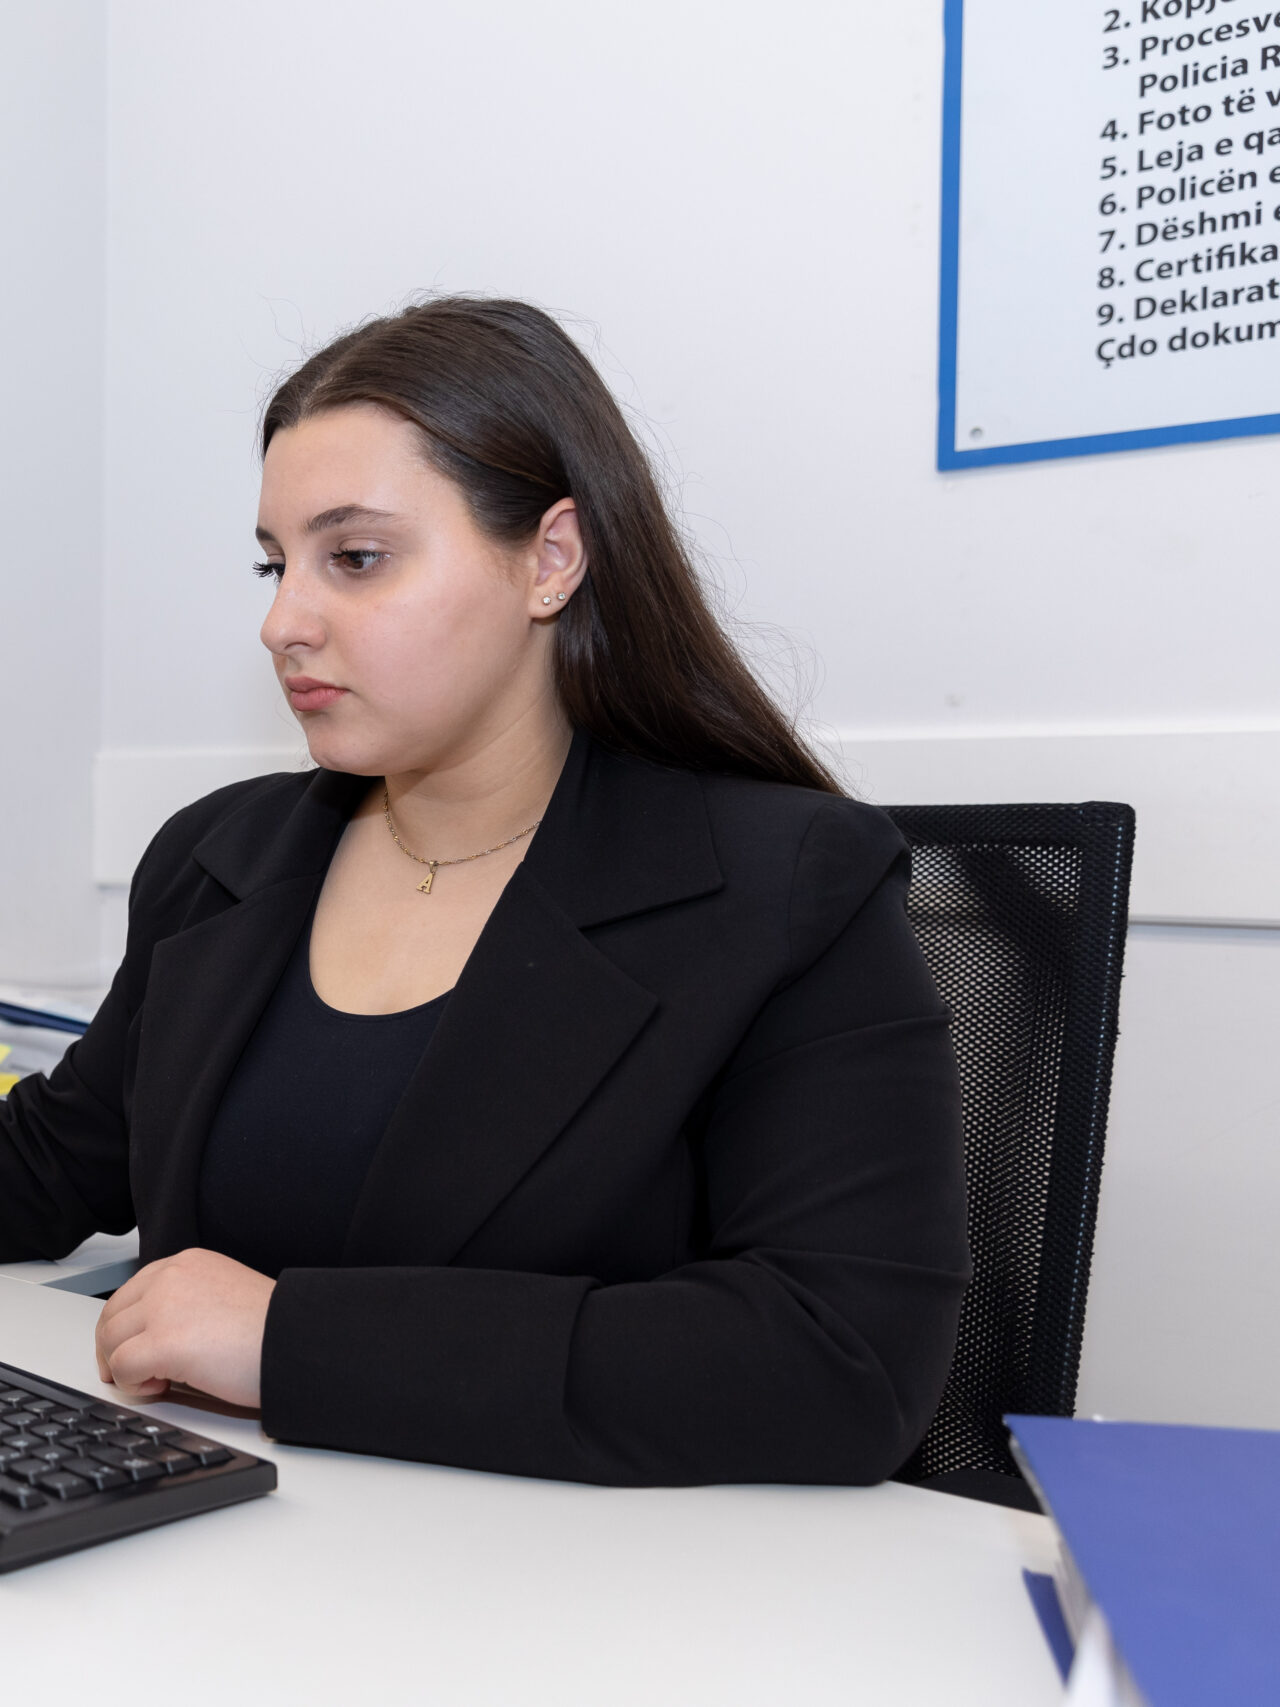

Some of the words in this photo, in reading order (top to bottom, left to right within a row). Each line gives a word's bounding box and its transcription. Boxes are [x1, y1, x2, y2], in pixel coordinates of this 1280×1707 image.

[1103, 9, 1131, 33] 2.
[1103, 46, 1130, 70] 3.
[1139, 55, 1249, 98] Policia
[1100, 119, 1128, 142] 4.
[1138, 104, 1213, 136] Foto
[1221, 87, 1256, 117] të
[1100, 156, 1127, 180] 5.
[1137, 140, 1204, 173] Leja
[1214, 137, 1234, 157] e
[1099, 192, 1127, 216] 6.
[1137, 168, 1258, 210] Policën
[1099, 229, 1126, 253] 7.
[1136, 200, 1263, 247] Dëshmi
[1097, 266, 1125, 290] 8.
[1134, 241, 1279, 283] Certifika
[1097, 303, 1124, 327] 9.
[1134, 277, 1280, 321] Deklarat
[1096, 334, 1158, 369] Çdo
